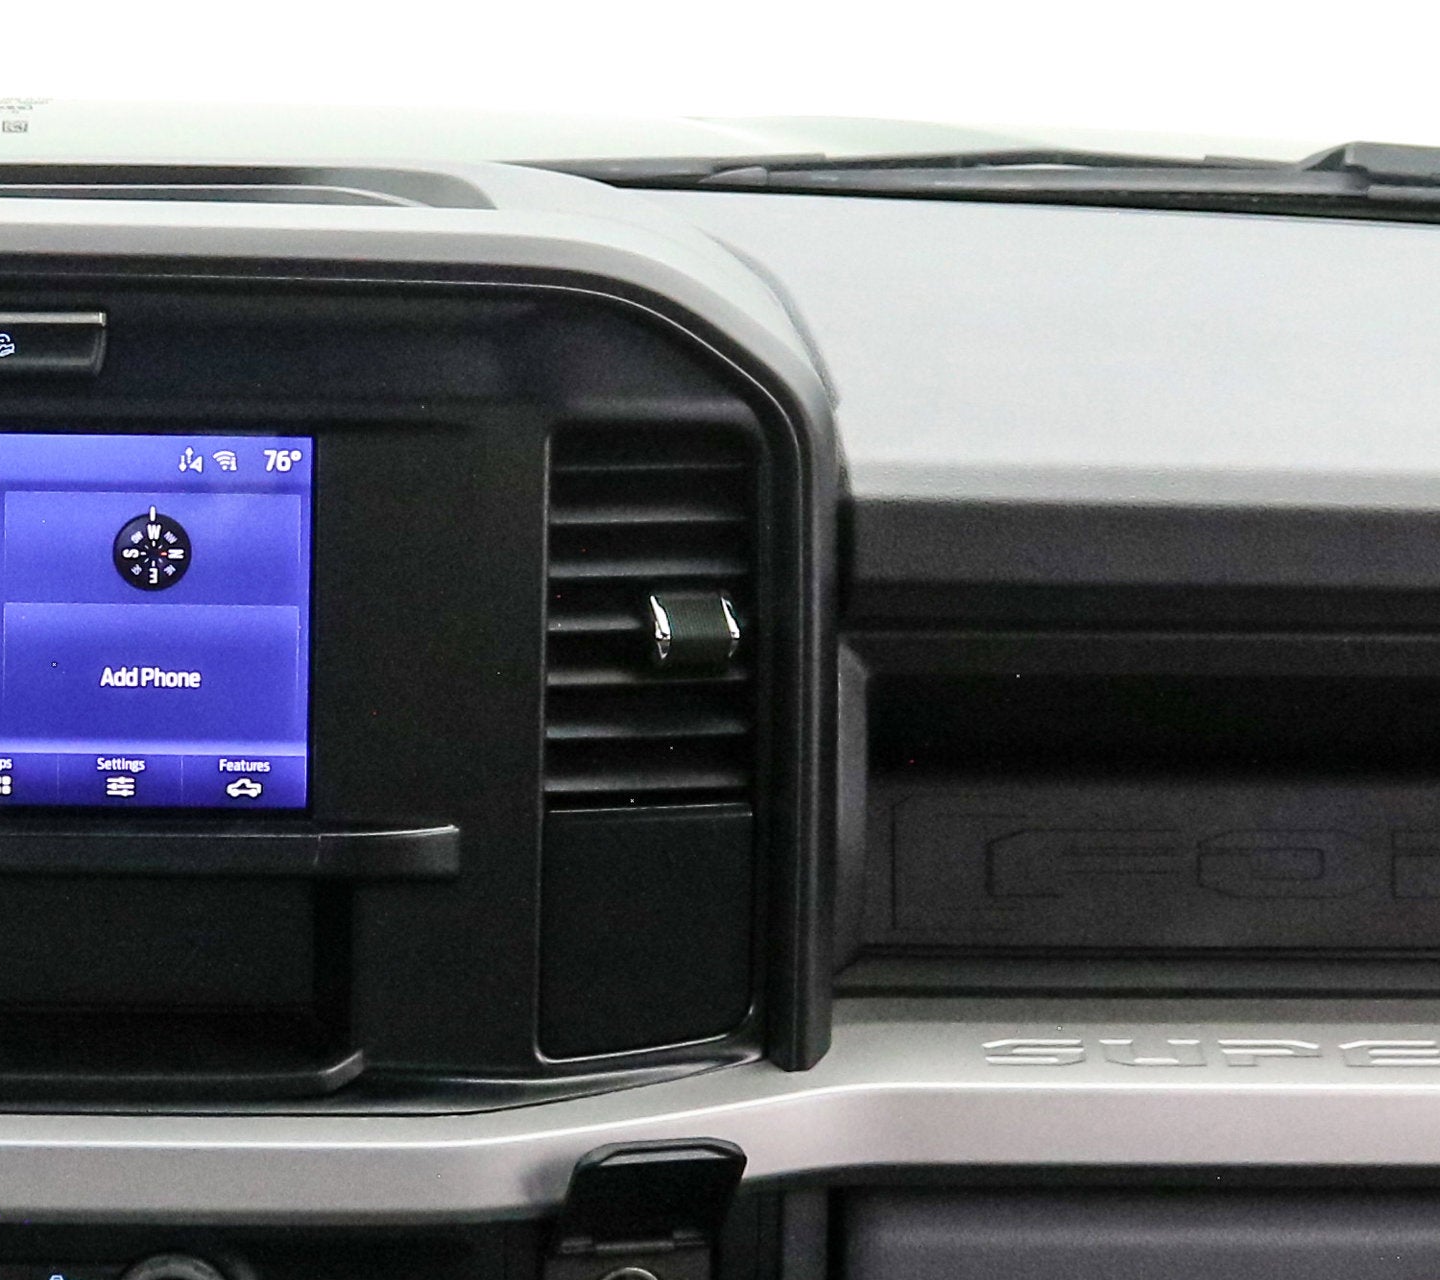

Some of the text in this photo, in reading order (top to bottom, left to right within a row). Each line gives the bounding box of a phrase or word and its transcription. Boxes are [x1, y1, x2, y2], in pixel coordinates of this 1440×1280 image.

[264, 449, 302, 472] 76°
[147, 524, 161, 540] W
[168, 549, 184, 559] N
[149, 568, 158, 584] E
[100, 667, 201, 688] Add Phone
[97, 756, 146, 773] Settings
[219, 758, 271, 773] Features
